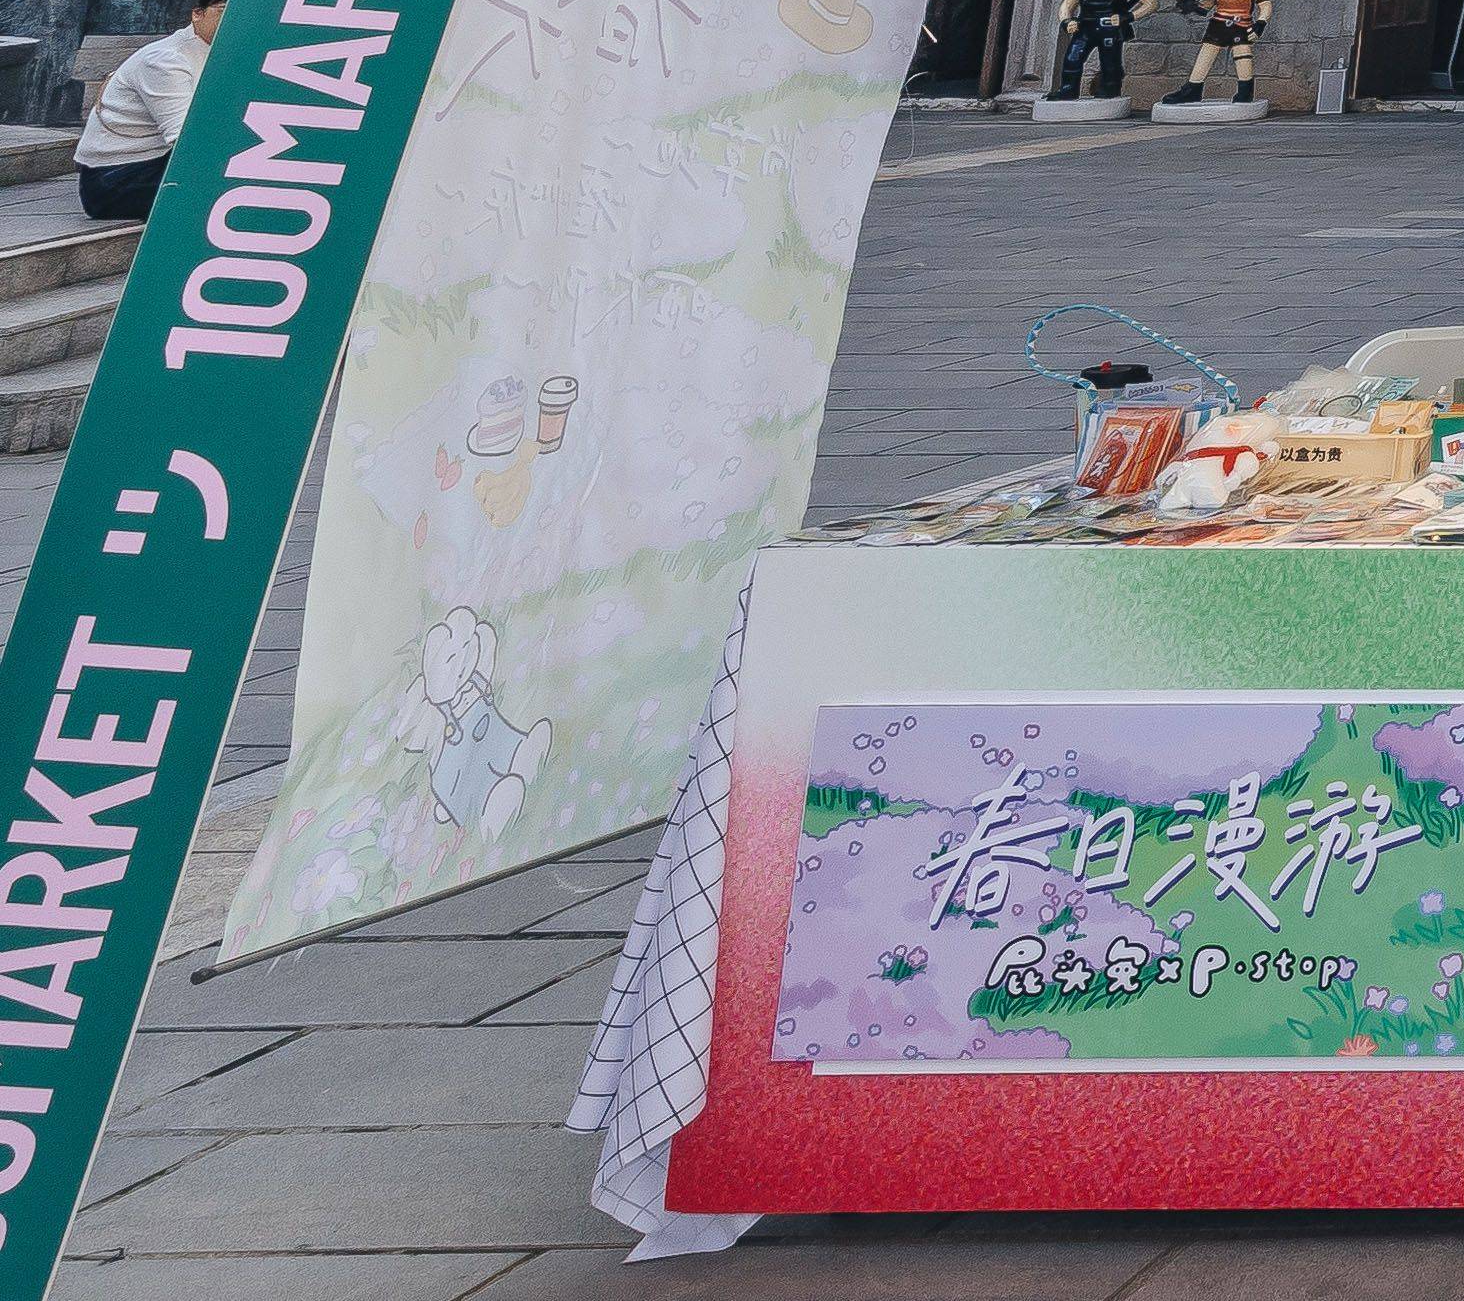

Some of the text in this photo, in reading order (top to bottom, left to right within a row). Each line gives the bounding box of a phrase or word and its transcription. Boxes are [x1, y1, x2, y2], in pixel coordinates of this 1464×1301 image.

[1279, 446, 1343, 463] 以盒为贵
[0, 615, 192, 1251] ARKET
[927, 762, 1424, 933] 春日漫游
